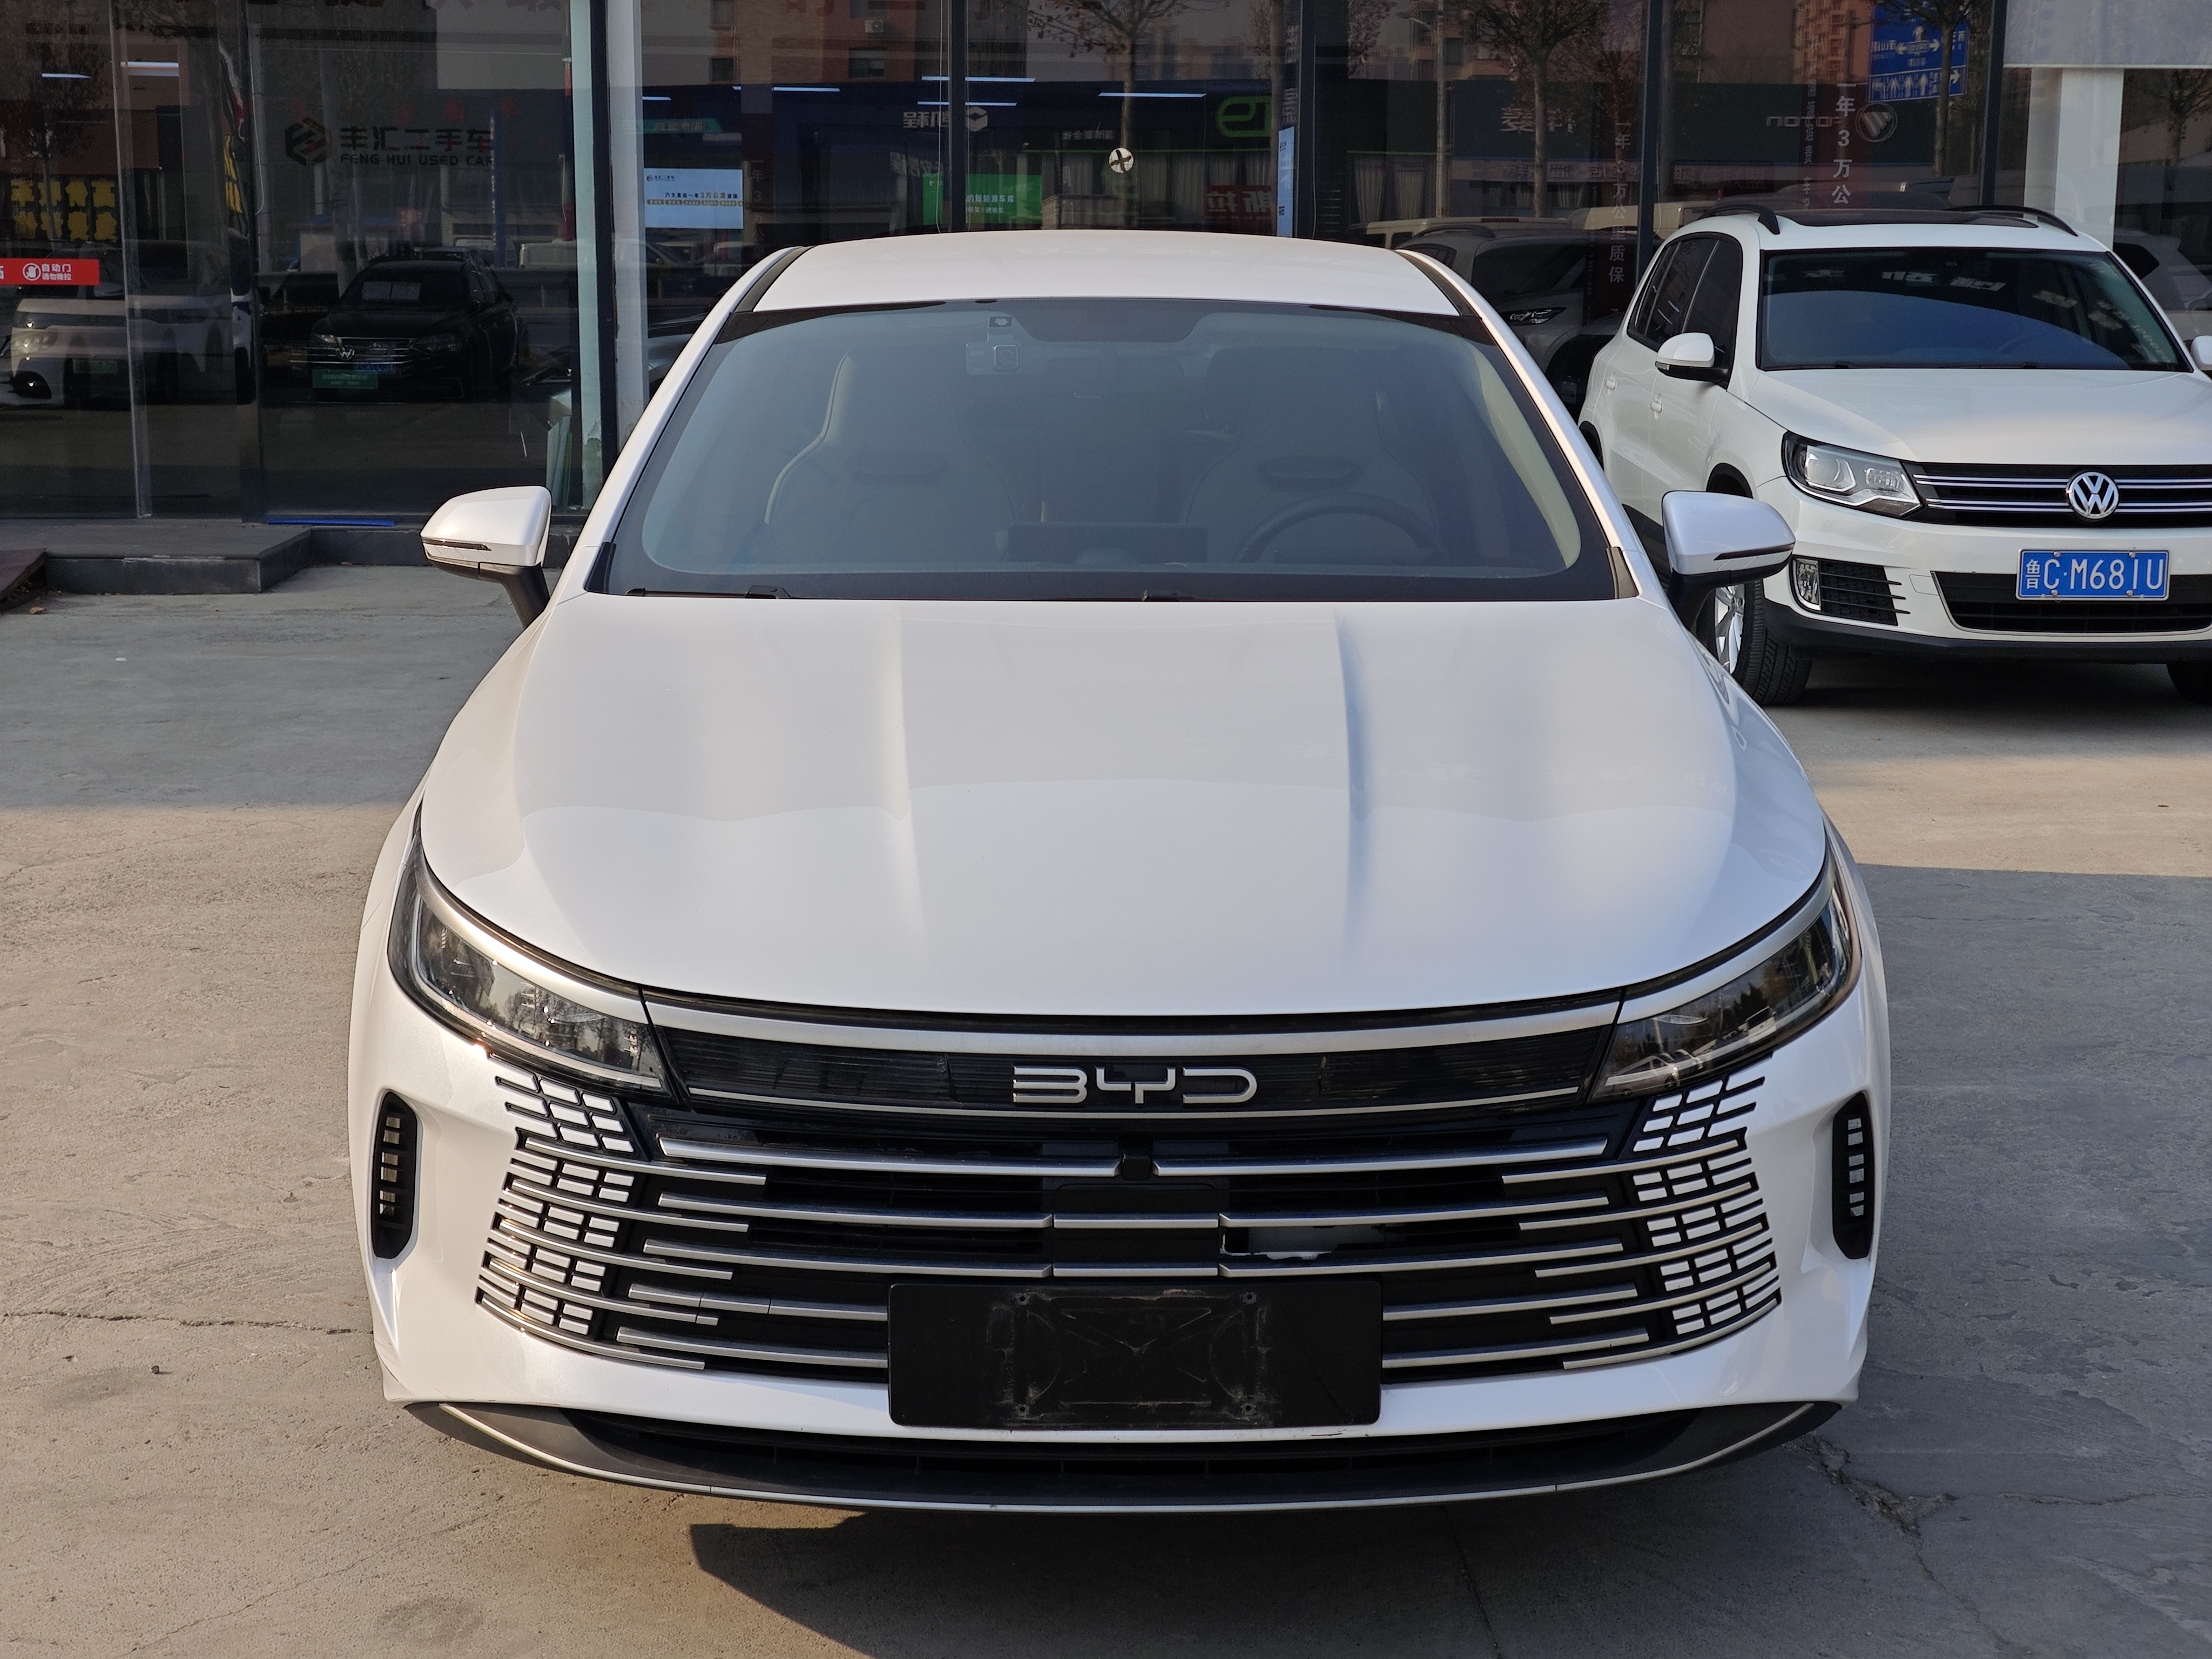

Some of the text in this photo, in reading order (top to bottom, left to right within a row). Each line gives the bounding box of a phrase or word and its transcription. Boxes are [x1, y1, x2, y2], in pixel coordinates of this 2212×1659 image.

[340, 126, 494, 152] 丰汇二手车
[341, 153, 380, 165] FENG
[387, 153, 412, 165] HUI
[419, 154, 458, 165] USED
[41, 264, 71, 272] 自动门
[42, 273, 72, 281] 请勿推拉
[1013, 1066, 1257, 1104] BYD
